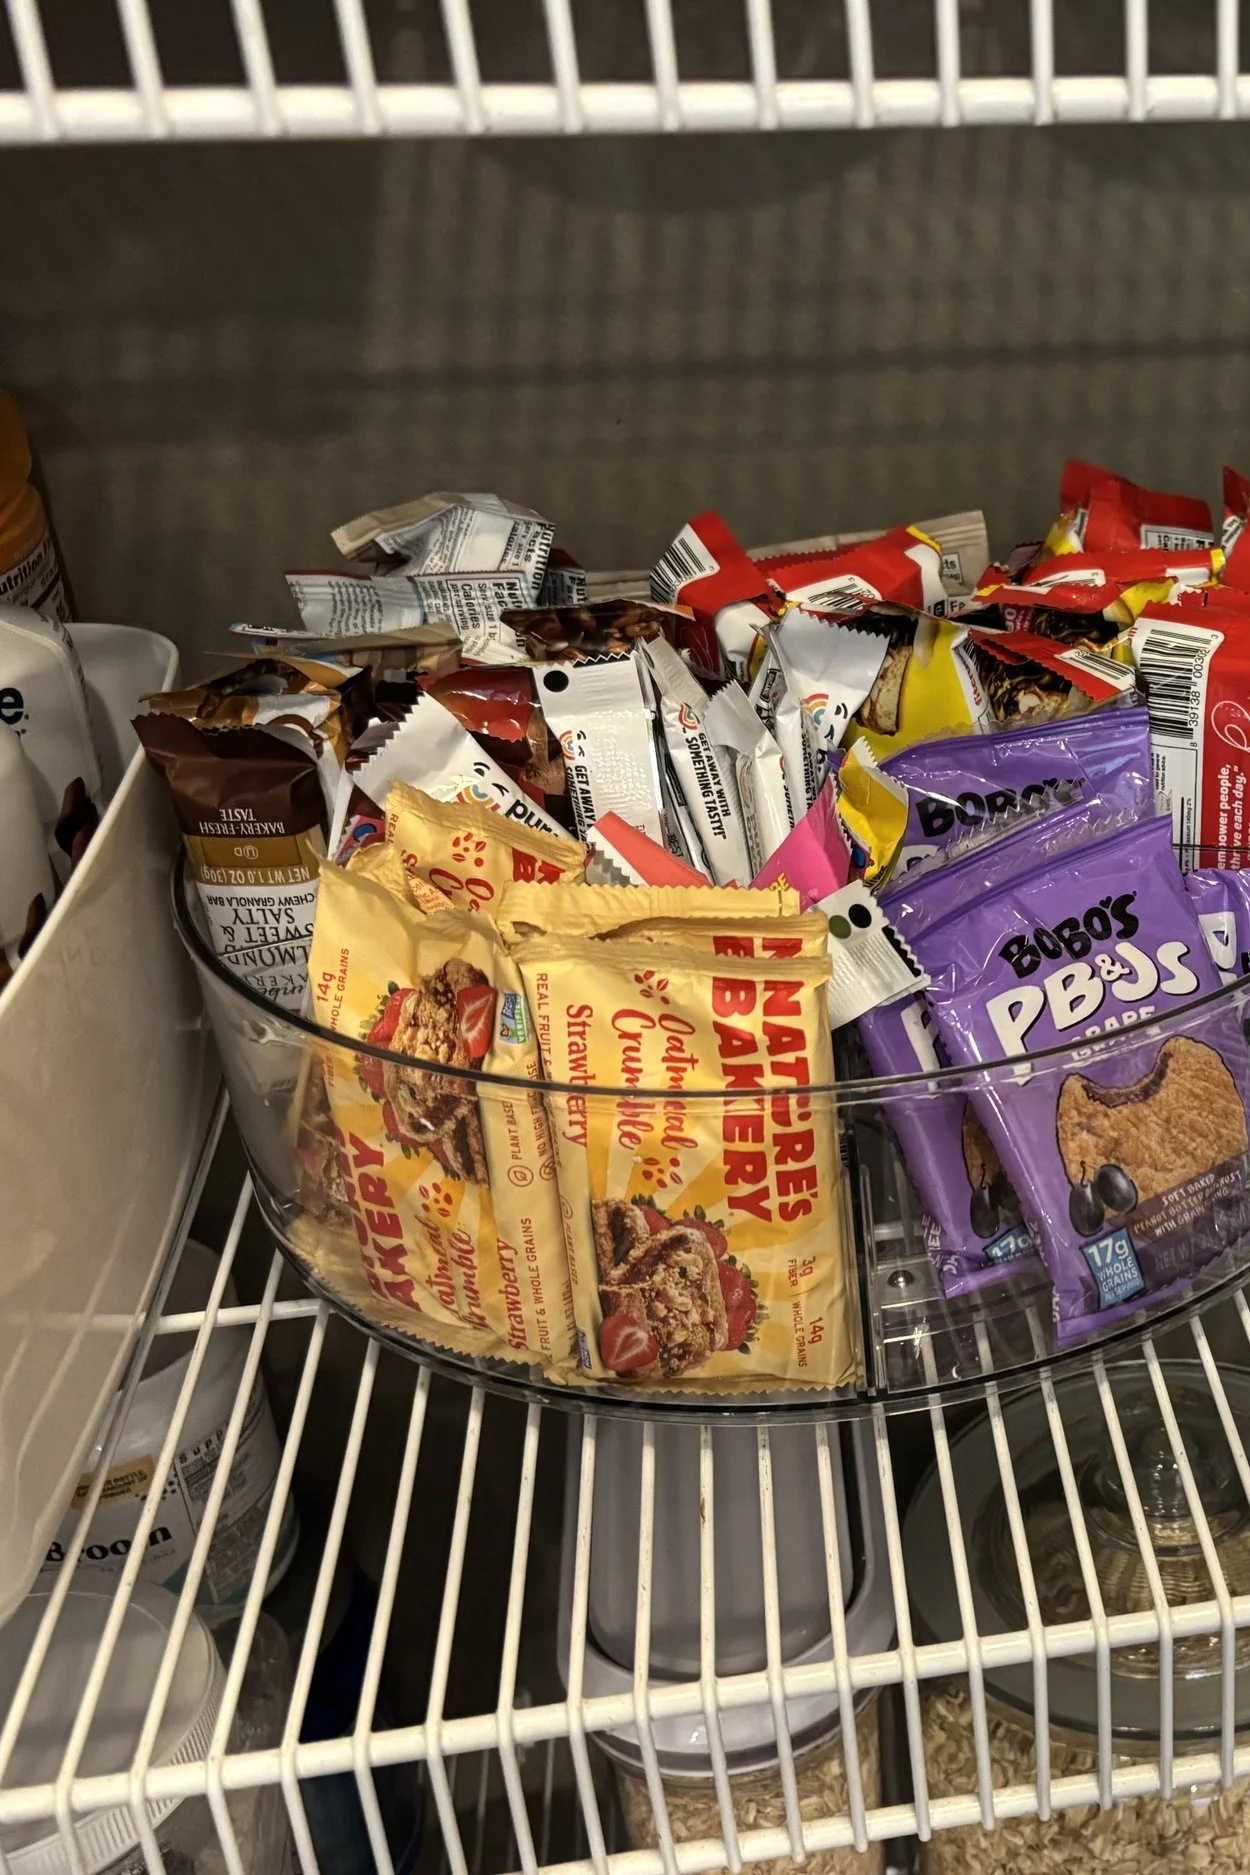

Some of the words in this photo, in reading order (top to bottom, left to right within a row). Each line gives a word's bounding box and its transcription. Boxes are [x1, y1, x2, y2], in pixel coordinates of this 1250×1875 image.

[532, 523, 556, 590] Nutrition
[0, 553, 44, 595] utrition
[462, 584, 480, 629] Calories
[1189, 691, 1201, 727] 39138
[574, 765, 588, 786] GET
[686, 736, 714, 798] SOMETHING
[703, 746, 719, 783] AWAY
[716, 784, 731, 817] WITH
[1219, 764, 1231, 811] people,
[221, 808, 256, 821] TASTE
[577, 787, 596, 826] AWAY
[1234, 800, 1243, 832] each
[199, 822, 285, 834] BAKERY-FRESH
[388, 813, 399, 845] REAL
[1230, 832, 1243, 870] thrve
[201, 867, 228, 882] (30g)
[231, 870, 246, 883] OZ
[248, 871, 264, 883] 1.0
[269, 869, 286, 883] WT
[289, 867, 310, 881] NET
[206, 895, 226, 905] BAR
[227, 895, 276, 906] GRANOLA
[278, 892, 315, 906] CHEWY
[233, 908, 295, 925] SALTY
[224, 944, 312, 967] LMOND
[336, 948, 350, 992] GRAINS
[316, 972, 336, 1004] 14g
[537, 972, 548, 1013] REAL
[539, 1015, 552, 1056] FRUIT
[712, 977, 773, 1223] BAKERY
[535, 1117, 546, 1141] HIGH
[511, 1132, 523, 1161] PLANT
[539, 1142, 548, 1158] NO
[1161, 1187, 1187, 1207] SOFT
[1188, 1173, 1216, 1192] BAKED
[349, 1131, 422, 1312] AKERY
[1155, 1222, 1177, 1237] WITH
[520, 1217, 537, 1264] GRAINS
[1089, 1237, 1128, 1268] 17g
[787, 1258, 798, 1287] FIBER
[801, 1256, 816, 1276] 3g
[1098, 1256, 1134, 1282] WHOLE
[1102, 1267, 1138, 1293] GRAINS
[497, 1238, 527, 1351] Strawberry
[530, 1265, 544, 1304] WHOLE
[791, 1301, 804, 1333] WHOLE
[809, 1316, 823, 1344] 14g
[540, 1319, 552, 1351] FRUIT
[794, 1334, 808, 1368] GRAINS
